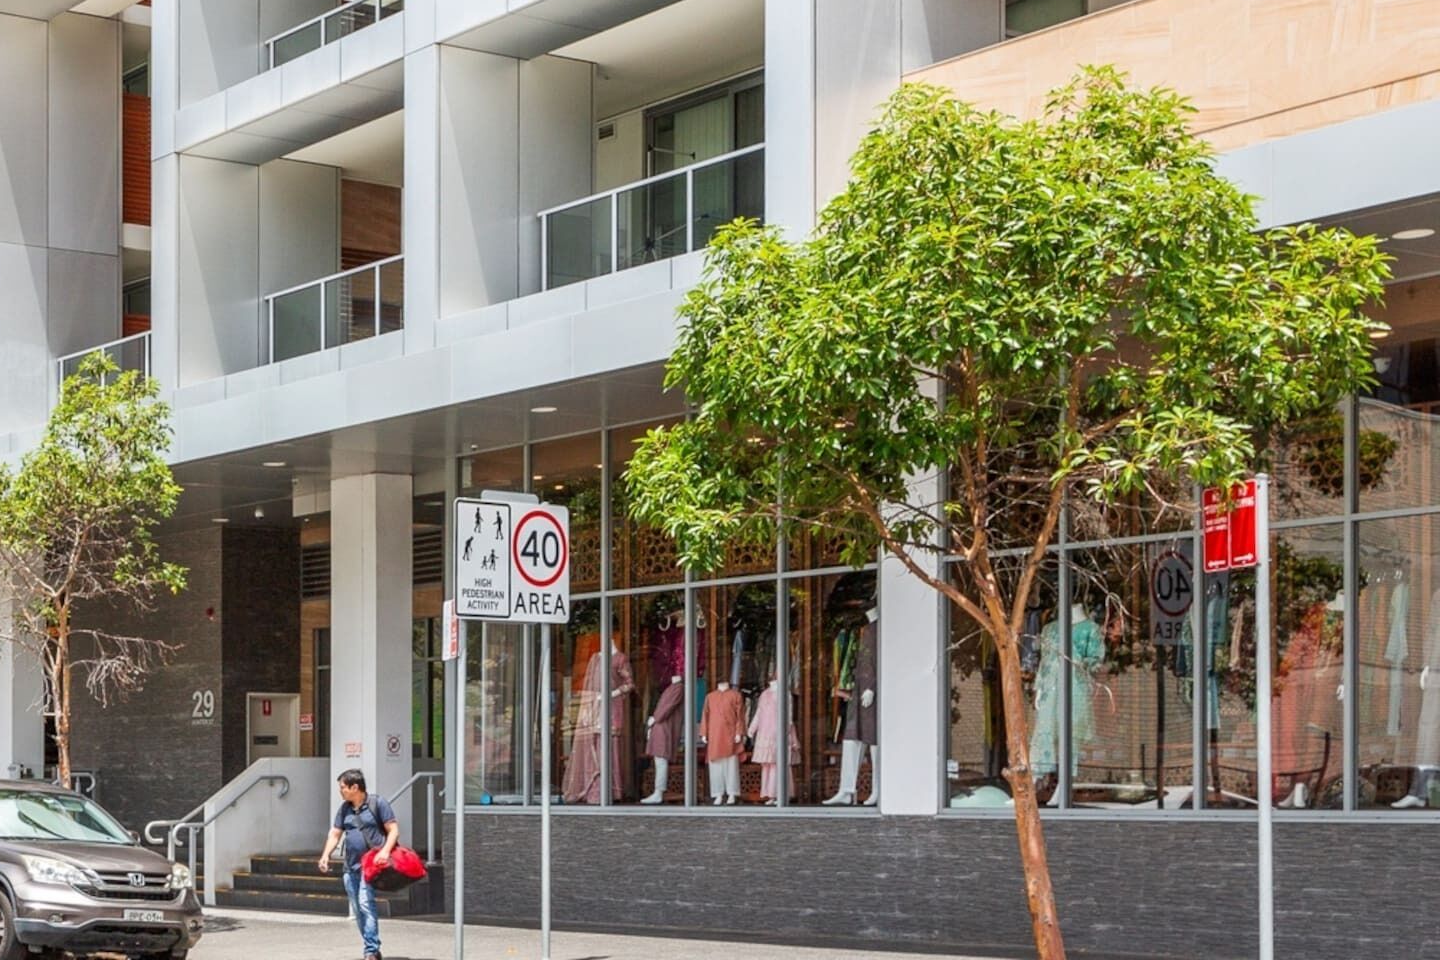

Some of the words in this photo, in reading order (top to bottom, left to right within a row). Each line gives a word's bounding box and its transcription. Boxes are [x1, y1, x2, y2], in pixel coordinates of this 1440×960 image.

[521, 530, 560, 568] 40
[474, 578, 492, 588] HIGH
[462, 588, 505, 599] PEDESTRIAN
[467, 600, 499, 610] ACTIVITY
[514, 592, 566, 616] AREA
[192, 690, 214, 717] 29
